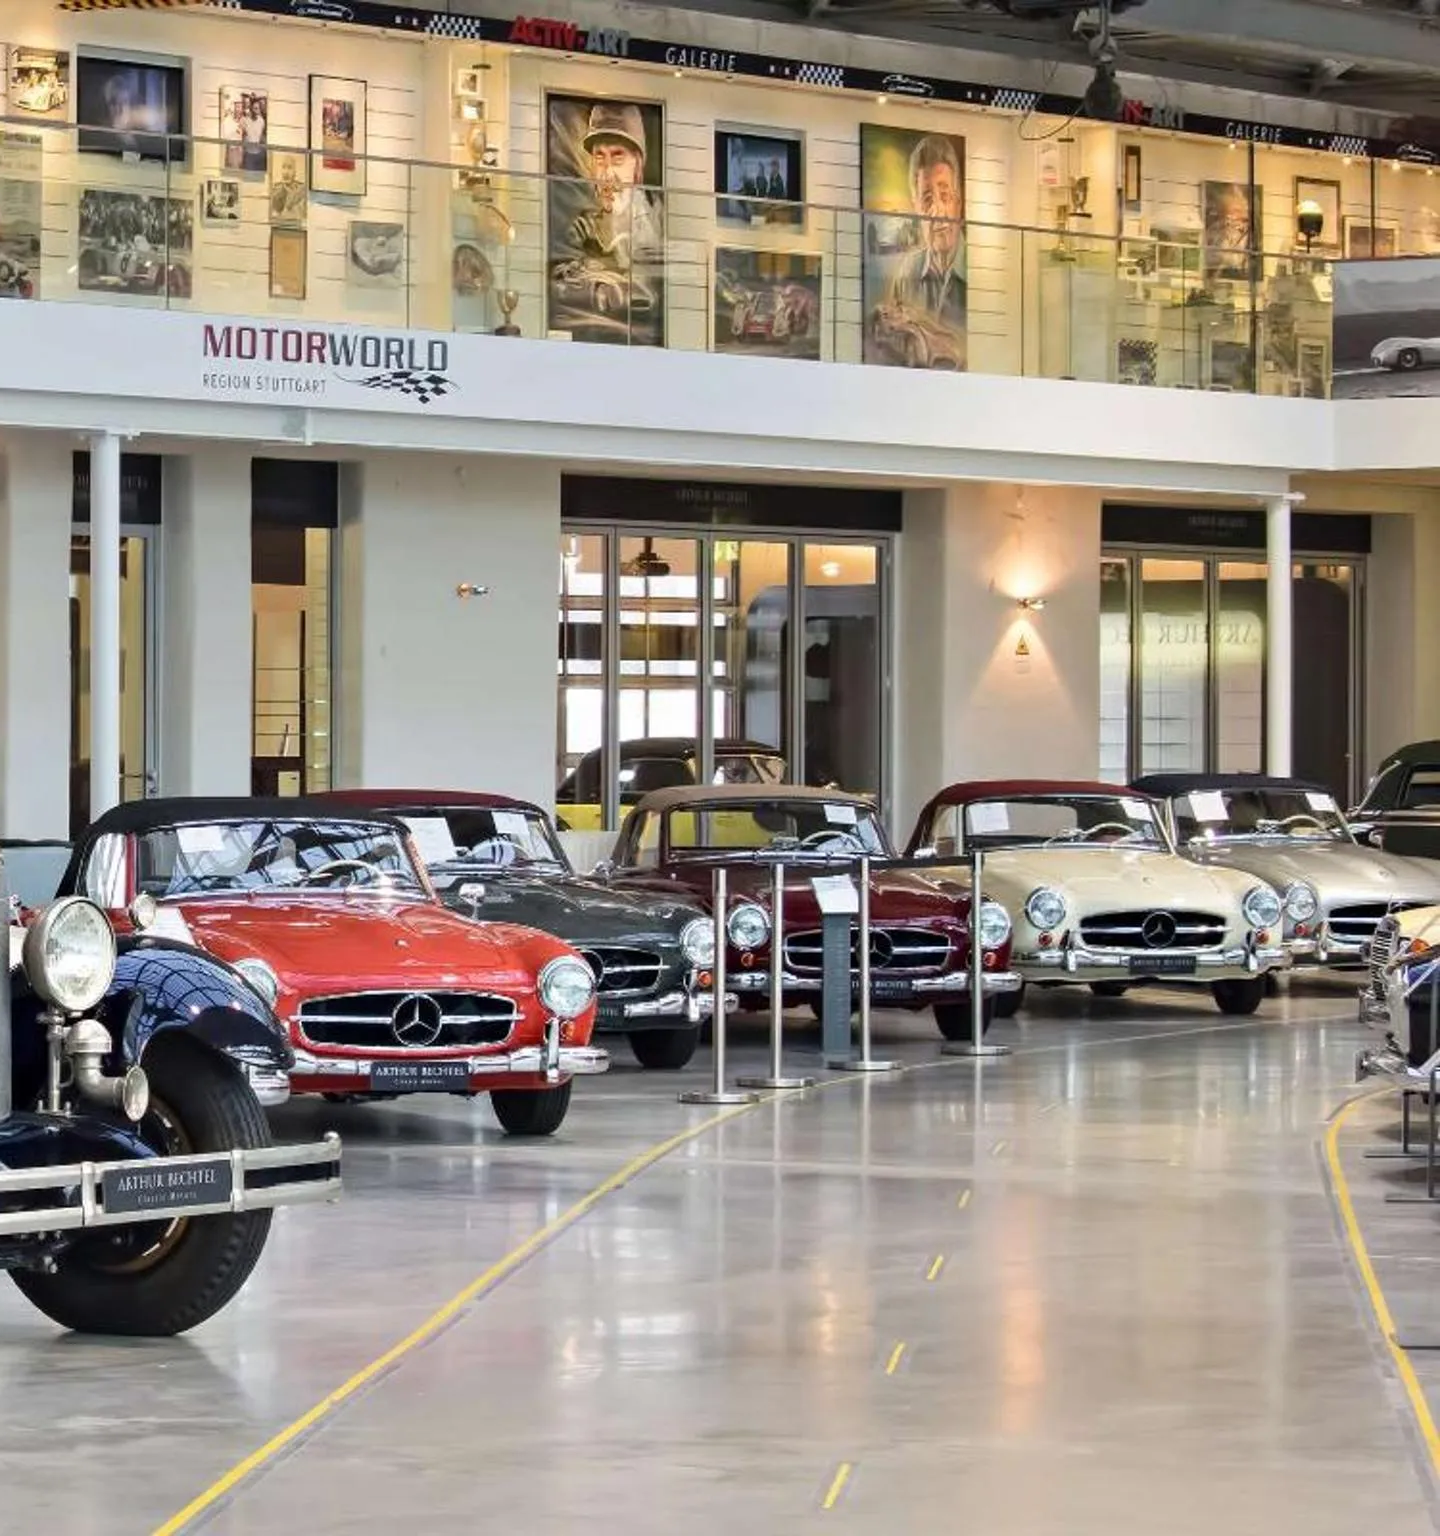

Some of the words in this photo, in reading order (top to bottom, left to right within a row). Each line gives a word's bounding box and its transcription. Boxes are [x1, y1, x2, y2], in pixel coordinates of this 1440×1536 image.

[665, 47, 737, 72] GALERIE
[1225, 122, 1283, 143] GALERIE
[203, 324, 448, 372] MOTORWORLD
[203, 373, 252, 391] REGION
[256, 376, 327, 394] STUTTGART
[375, 1066, 418, 1077] ARTHUR
[118, 1172, 165, 1193] ARTHUR
[167, 1167, 217, 1188] BECHTEL
